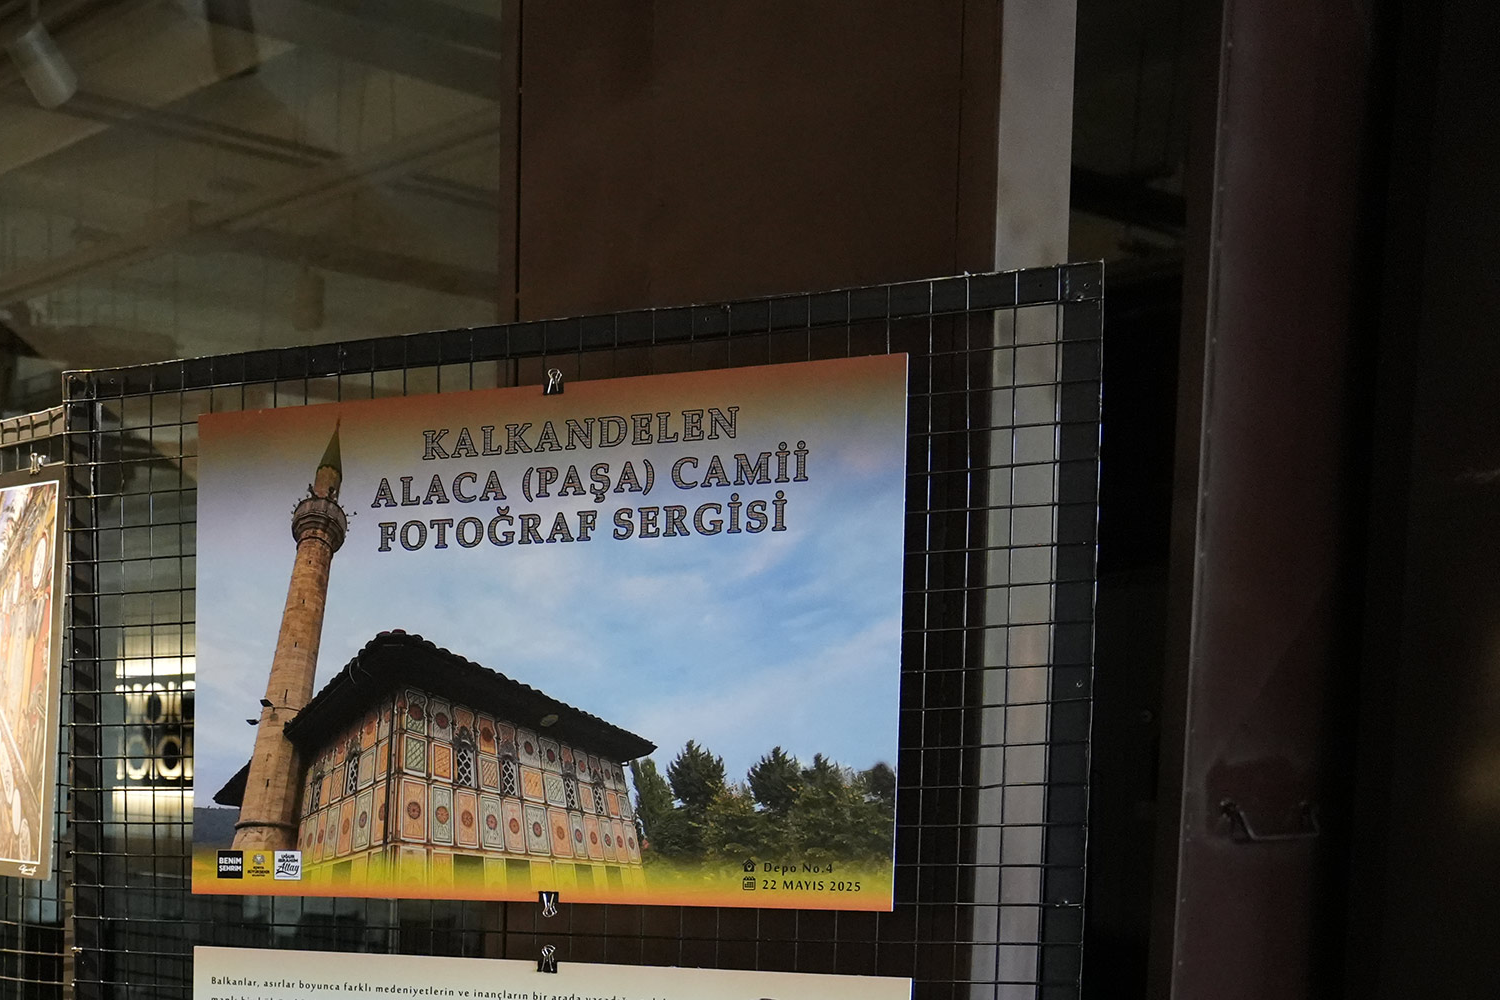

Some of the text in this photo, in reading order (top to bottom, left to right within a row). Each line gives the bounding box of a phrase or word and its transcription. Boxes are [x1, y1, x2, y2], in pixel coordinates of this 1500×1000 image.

[422, 406, 740, 460] KALKANDELEN
[370, 440, 809, 508] ALACA (PAŞA) CAMİİ
[377, 490, 787, 552] FOTOĞRAF SERGİSİ
[762, 879, 861, 892] 22 MAYIS 2025
[763, 862, 833, 876] Depo No.4
[211, 976, 260, 987] Balkanlar,
[263, 979, 296, 988] asırlar
[298, 979, 341, 992] boyunca
[343, 982, 372, 992] farklı
[375, 984, 455, 997] medeniyetlerin
[473, 989, 529, 1000] inançların
[532, 991, 548, 1000] bir
